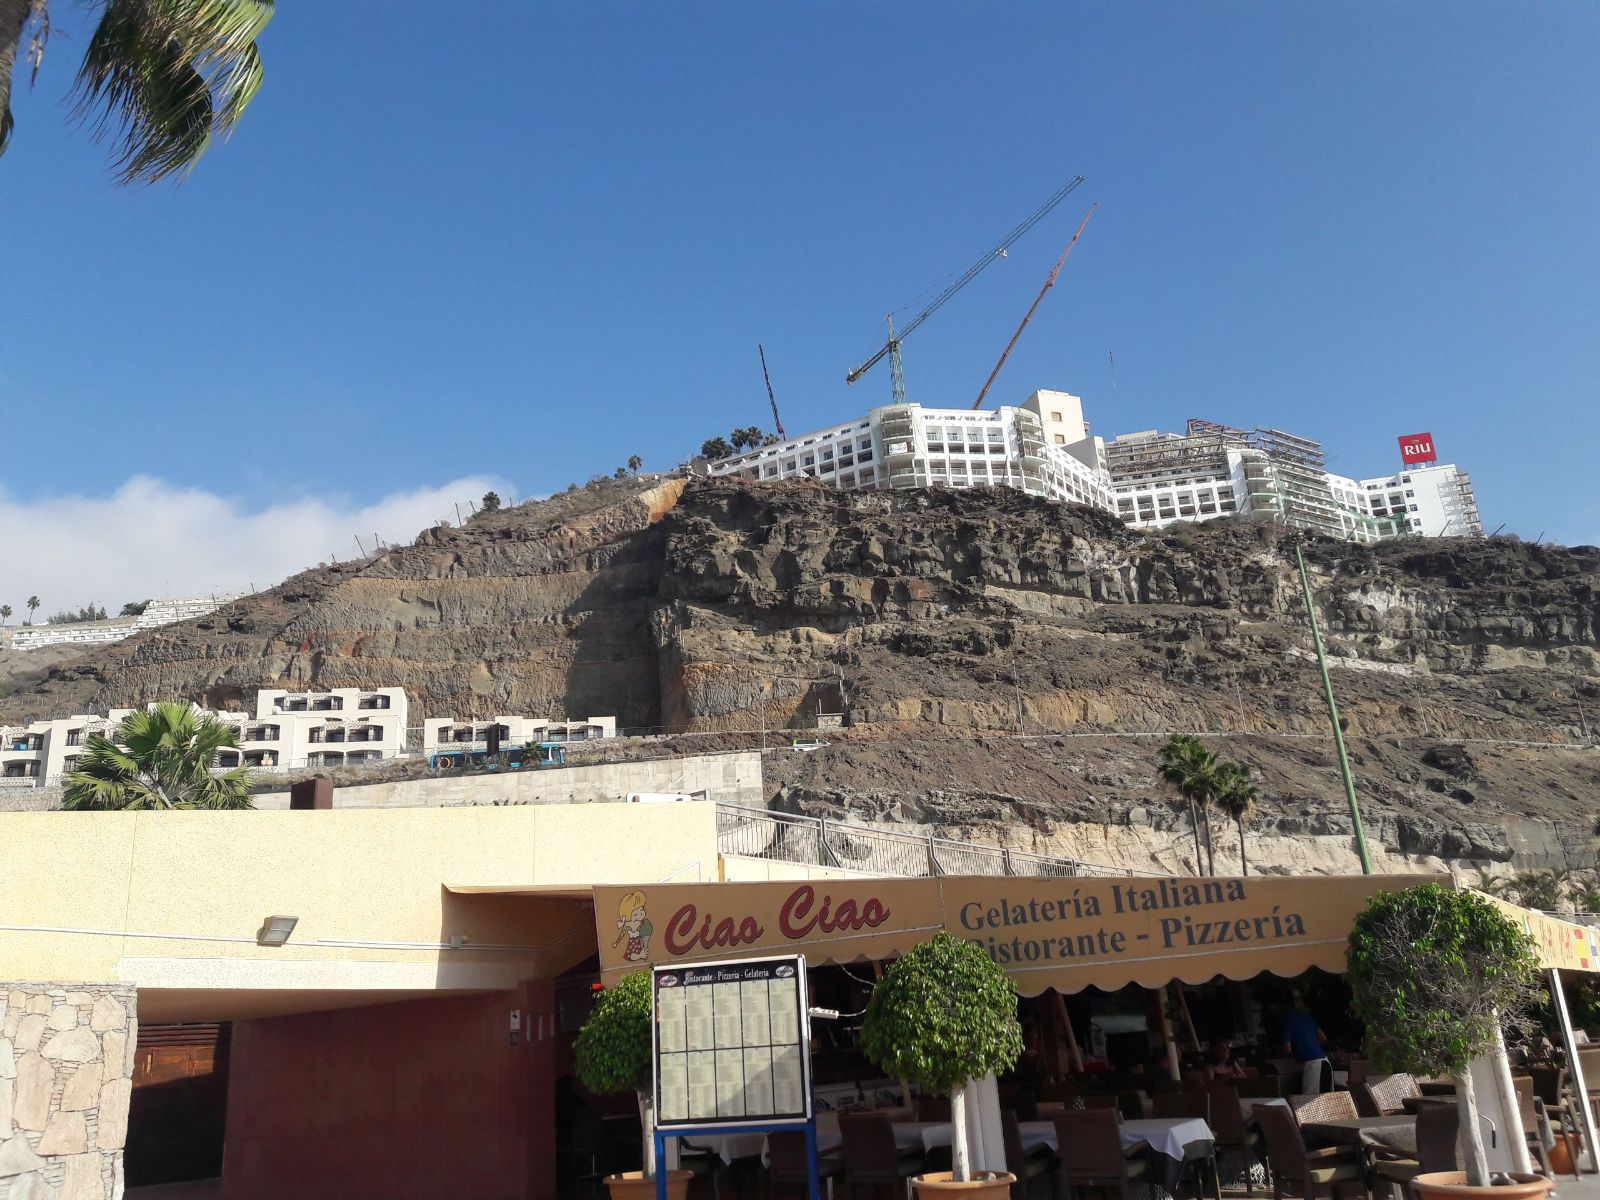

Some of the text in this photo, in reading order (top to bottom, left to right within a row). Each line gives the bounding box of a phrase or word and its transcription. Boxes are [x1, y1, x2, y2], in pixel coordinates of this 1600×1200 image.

[1404, 442, 1431, 456] RIU
[664, 885, 891, 955] Ciao Ciao
[960, 878, 1247, 931] Gelatería Italiana
[1158, 905, 1307, 949] Pizzería
